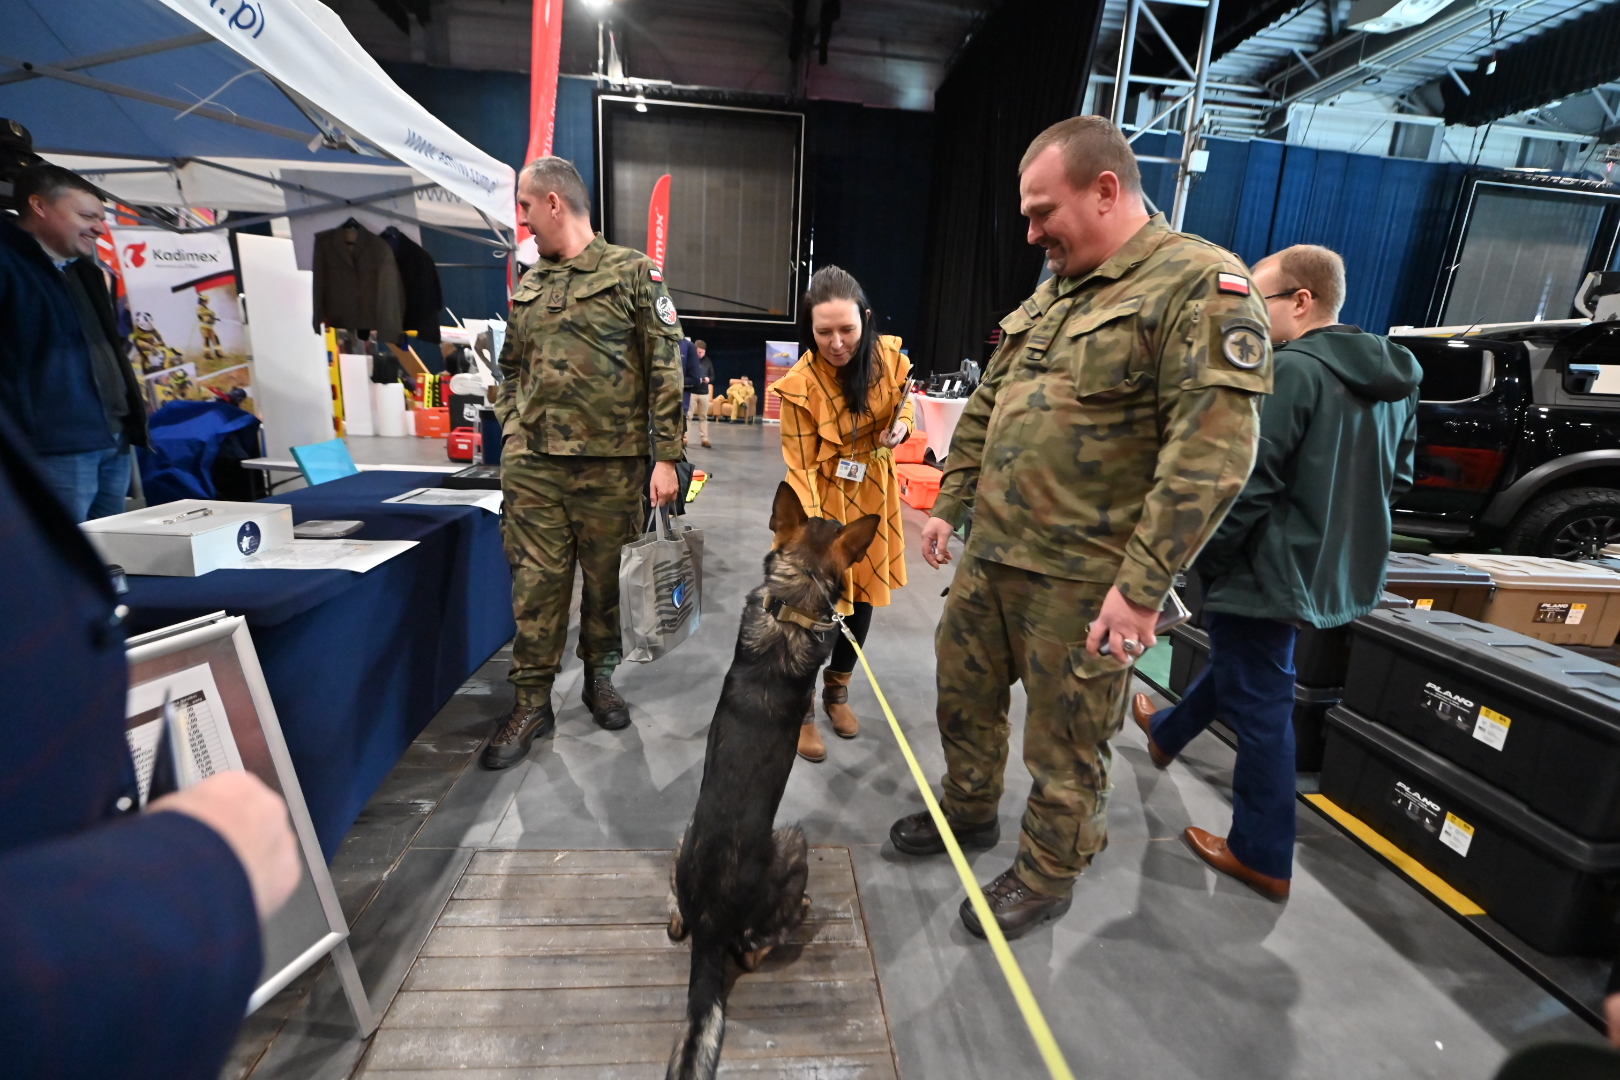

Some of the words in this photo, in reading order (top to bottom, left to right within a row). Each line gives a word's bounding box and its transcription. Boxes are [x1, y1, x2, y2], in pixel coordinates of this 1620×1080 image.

[152, 249, 218, 263] Kadimex
[1426, 682, 1474, 708] PLANO
[1396, 781, 1441, 812] PLANO
